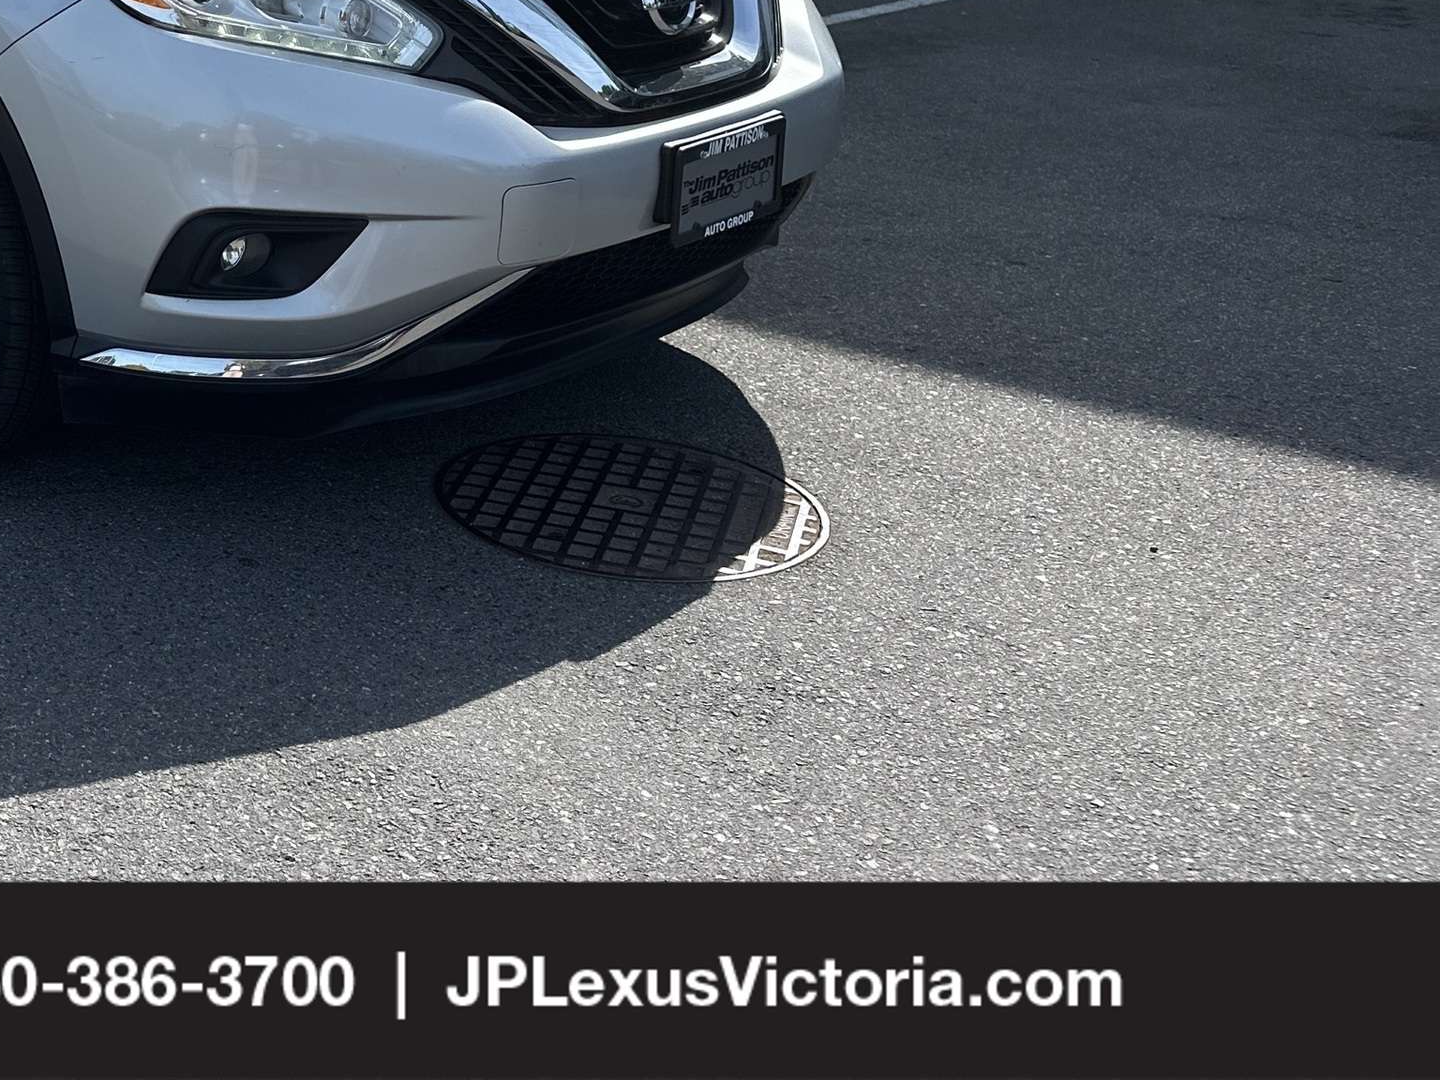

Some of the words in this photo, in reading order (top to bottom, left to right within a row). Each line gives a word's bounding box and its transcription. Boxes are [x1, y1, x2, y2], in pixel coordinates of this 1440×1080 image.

[705, 139, 722, 158] JIM
[724, 125, 765, 153] PATTISON
[689, 175, 716, 195] Jim
[716, 155, 774, 185] Pattison
[704, 220, 726, 237] AUTO
[726, 210, 755, 229] GROUP
